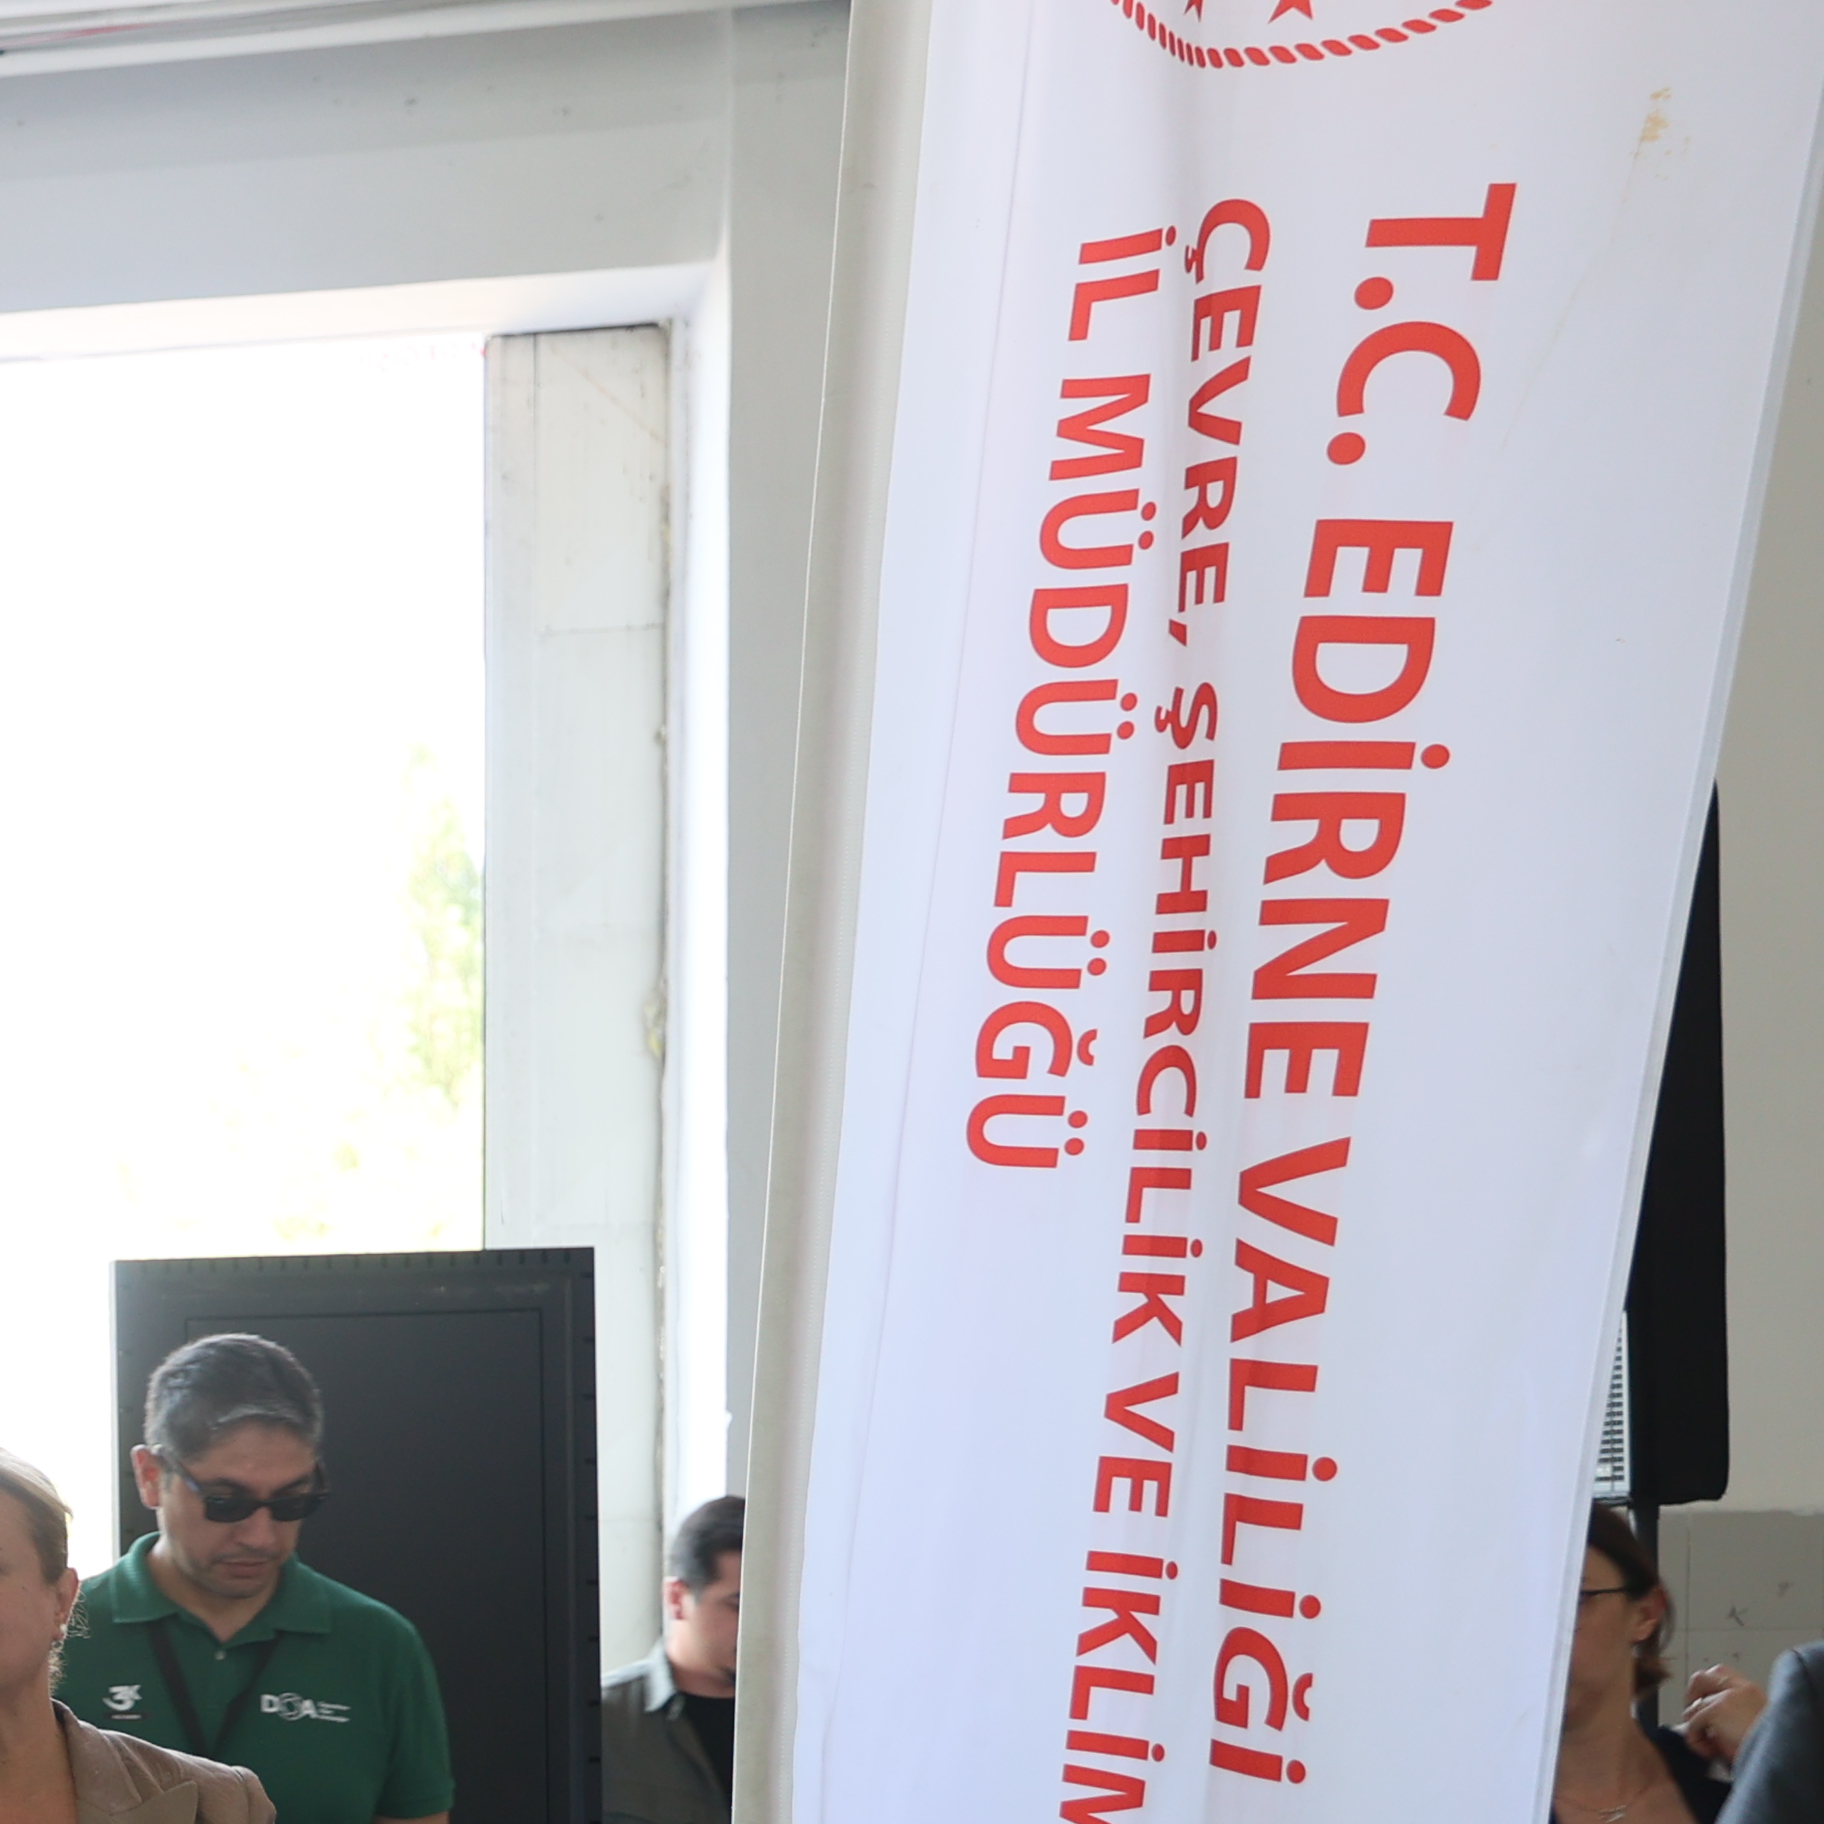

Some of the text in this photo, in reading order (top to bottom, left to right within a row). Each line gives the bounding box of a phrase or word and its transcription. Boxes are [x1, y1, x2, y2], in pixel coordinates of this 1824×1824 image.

[966, 225, 1178, 1170] İL MÜDÜRLÜĞÜ
[1168, 198, 1273, 647] ÇEVRE,
[1113, 681, 1219, 1345] ŞEHİRCİLİK
[1210, 181, 1518, 1785] T.C. EDİRNE VALİLİĞİ
[1093, 1372, 1181, 1519] VE
